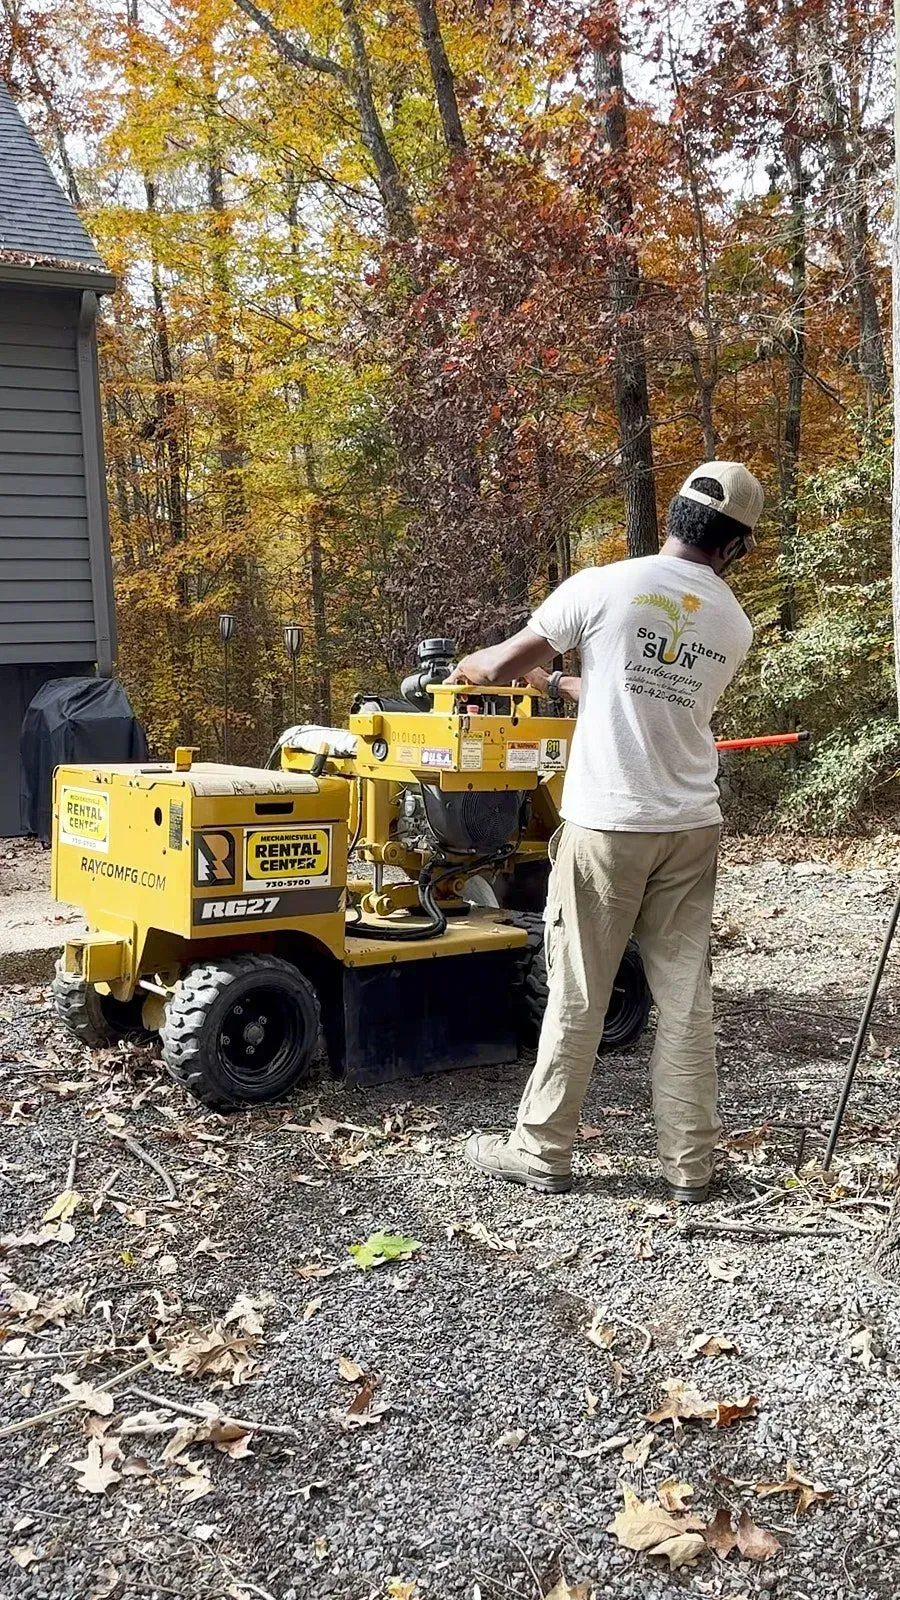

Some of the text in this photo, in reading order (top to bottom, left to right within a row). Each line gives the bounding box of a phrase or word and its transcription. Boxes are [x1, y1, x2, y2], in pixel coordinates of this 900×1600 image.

[625, 660, 703, 692] Landscaping
[547, 740, 560, 753] 811
[67, 802, 102, 820] RENTAL
[70, 817, 100, 832] CENTER
[261, 834, 317, 842] MECHANICSVILLE
[255, 843, 321, 858] RENTAL
[260, 858, 316, 872] CENTER
[80, 857, 166, 891] RAYCOMFG.COM
[201, 897, 280, 920] RG27
